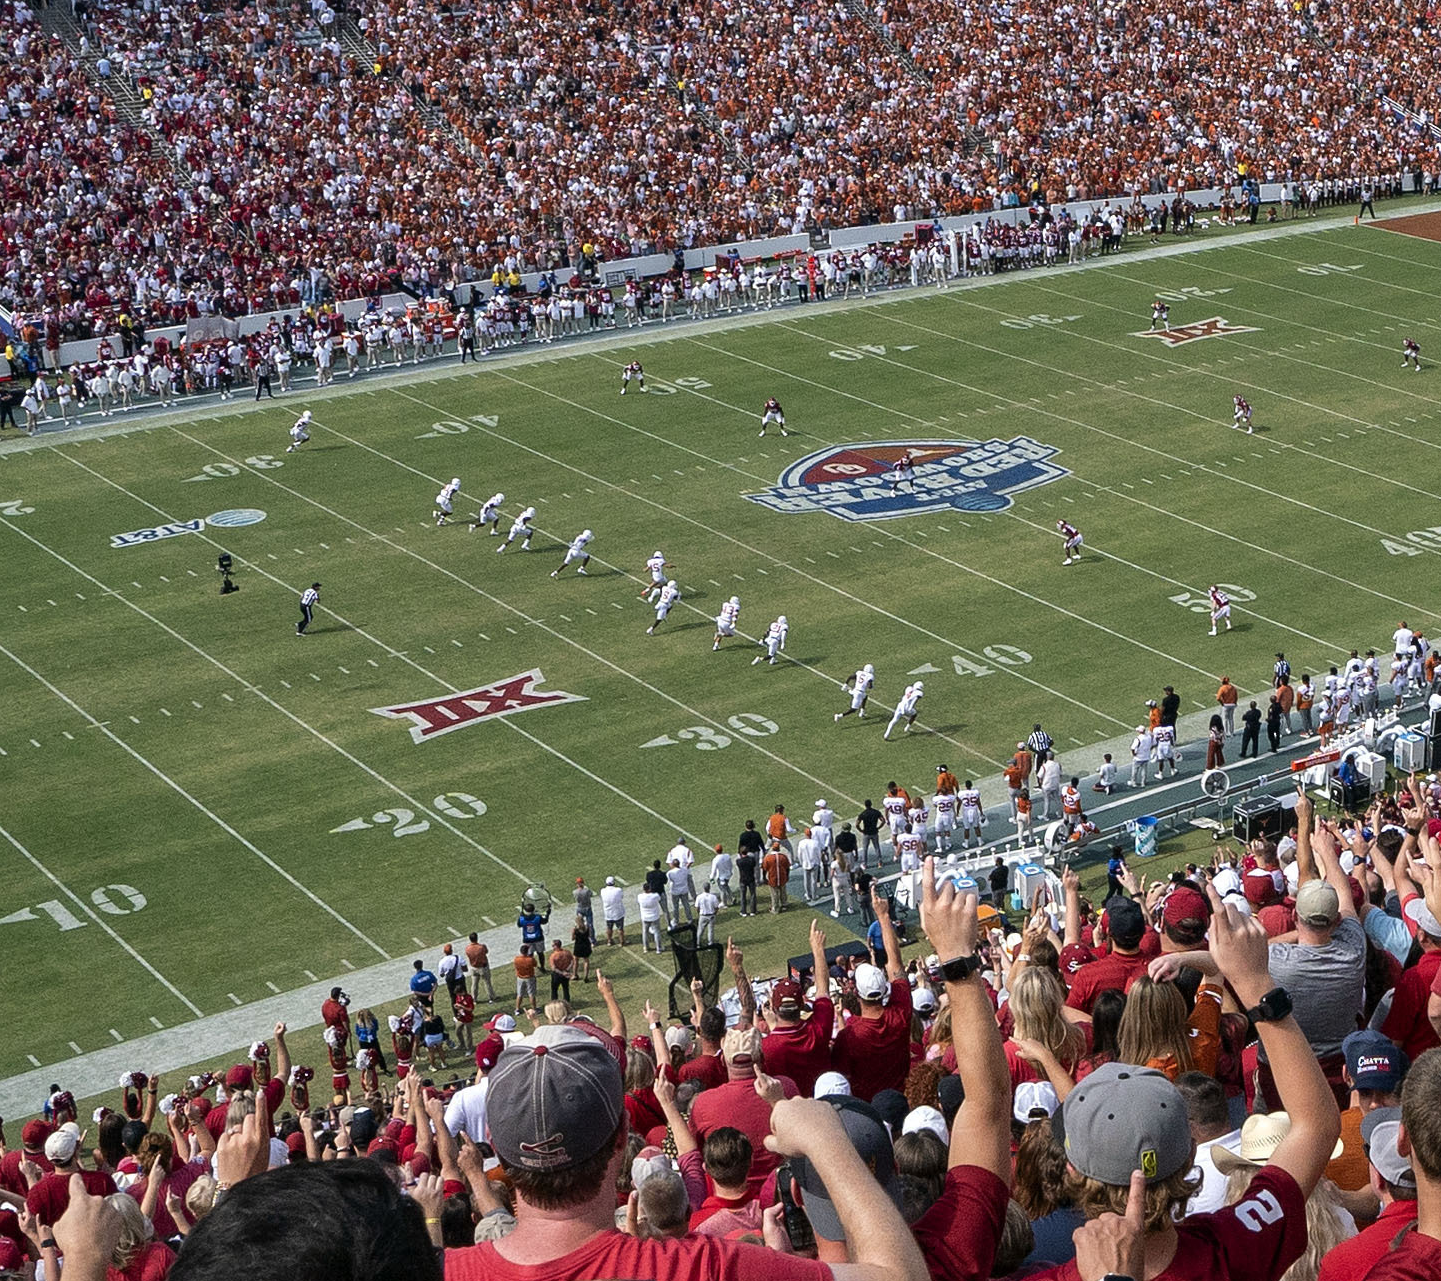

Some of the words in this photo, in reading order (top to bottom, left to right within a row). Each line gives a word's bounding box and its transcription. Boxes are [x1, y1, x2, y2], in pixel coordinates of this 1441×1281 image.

[1297, 261, 1347, 278] 10
[1155, 286, 1214, 303] 20
[999, 313, 1063, 330] 30
[828, 344, 886, 361] 40
[433, 414, 500, 437] 40
[202, 454, 284, 478] 30
[967, 438, 1059, 477] RED
[114, 520, 204, 547] AT&T
[951, 643, 1033, 677] 40
[678, 712, 780, 752] 30
[373, 791, 488, 839] 20
[24, 882, 147, 932] 10
[1235, 1188, 1283, 1232] 2
